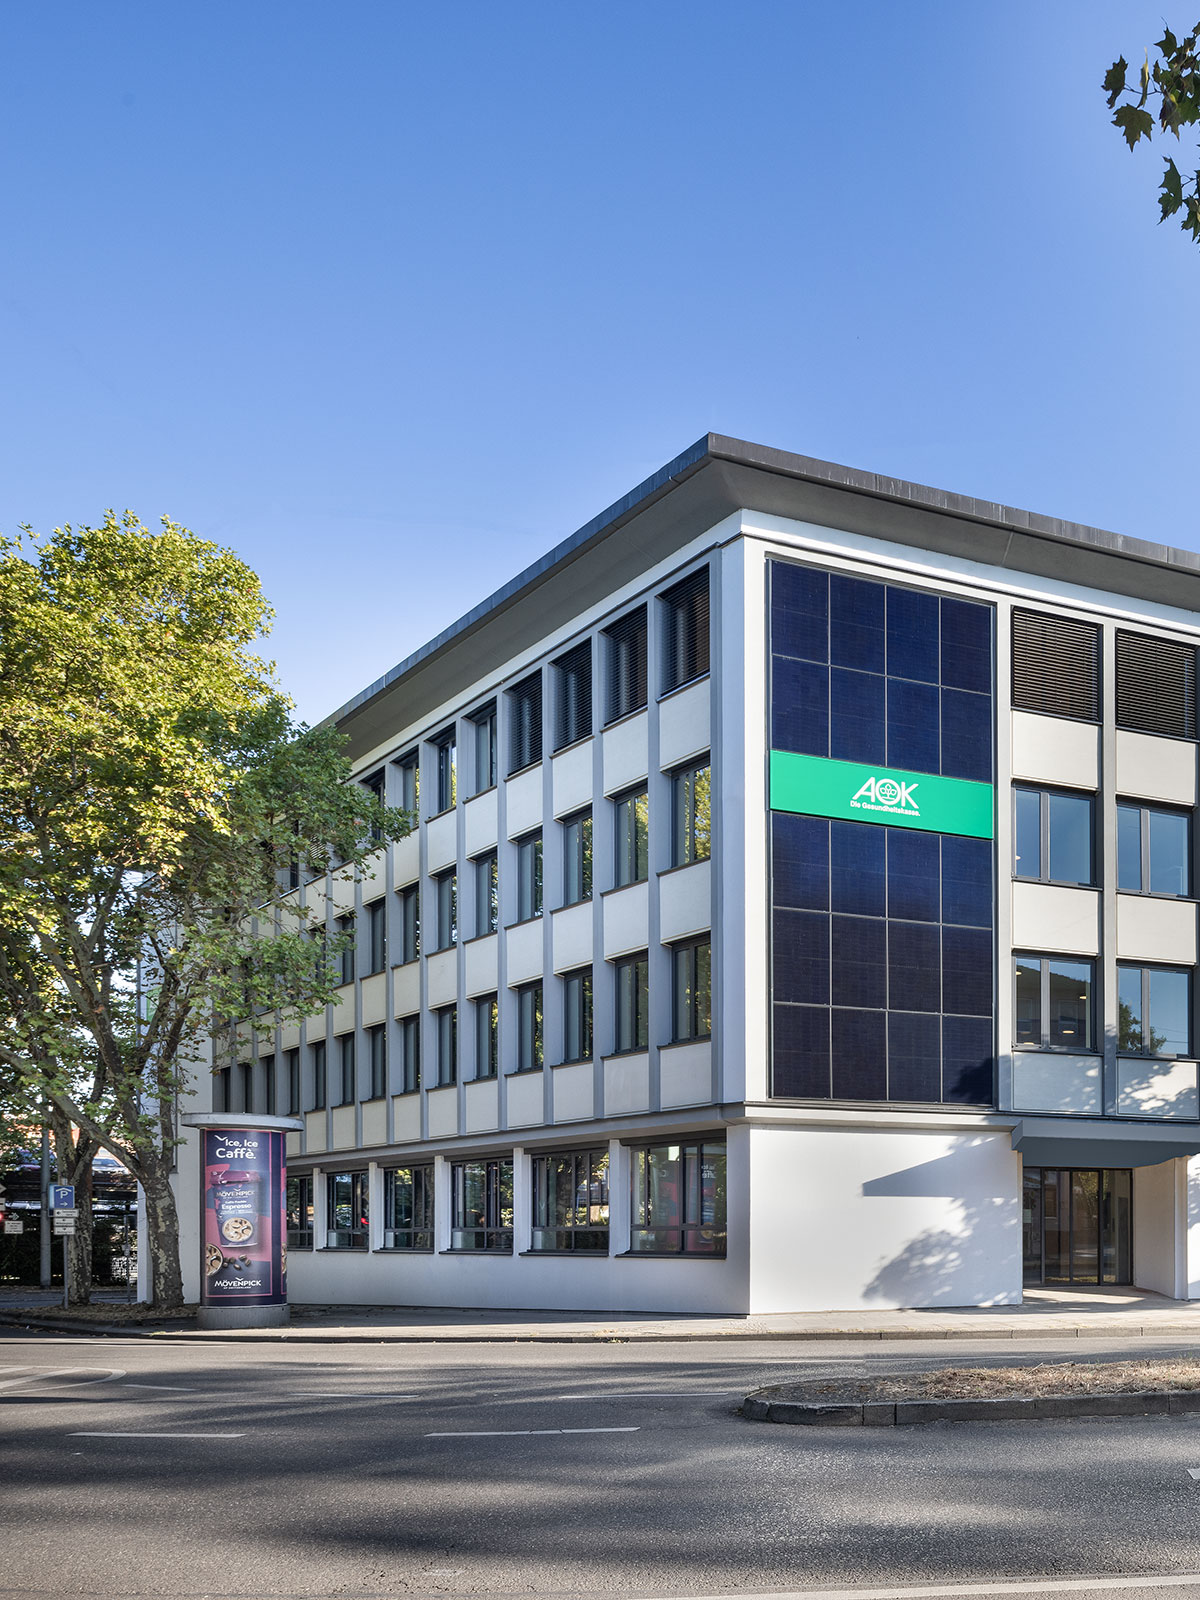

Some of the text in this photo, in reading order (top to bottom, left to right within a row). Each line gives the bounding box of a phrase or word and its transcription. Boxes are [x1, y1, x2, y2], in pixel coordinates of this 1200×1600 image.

[851, 776, 920, 809] AOK
[850, 800, 861, 808] Die
[225, 1139, 258, 1148] Ice, Ice
[216, 1148, 256, 1160] Caffè.
[60, 1190, 68, 1199] P
